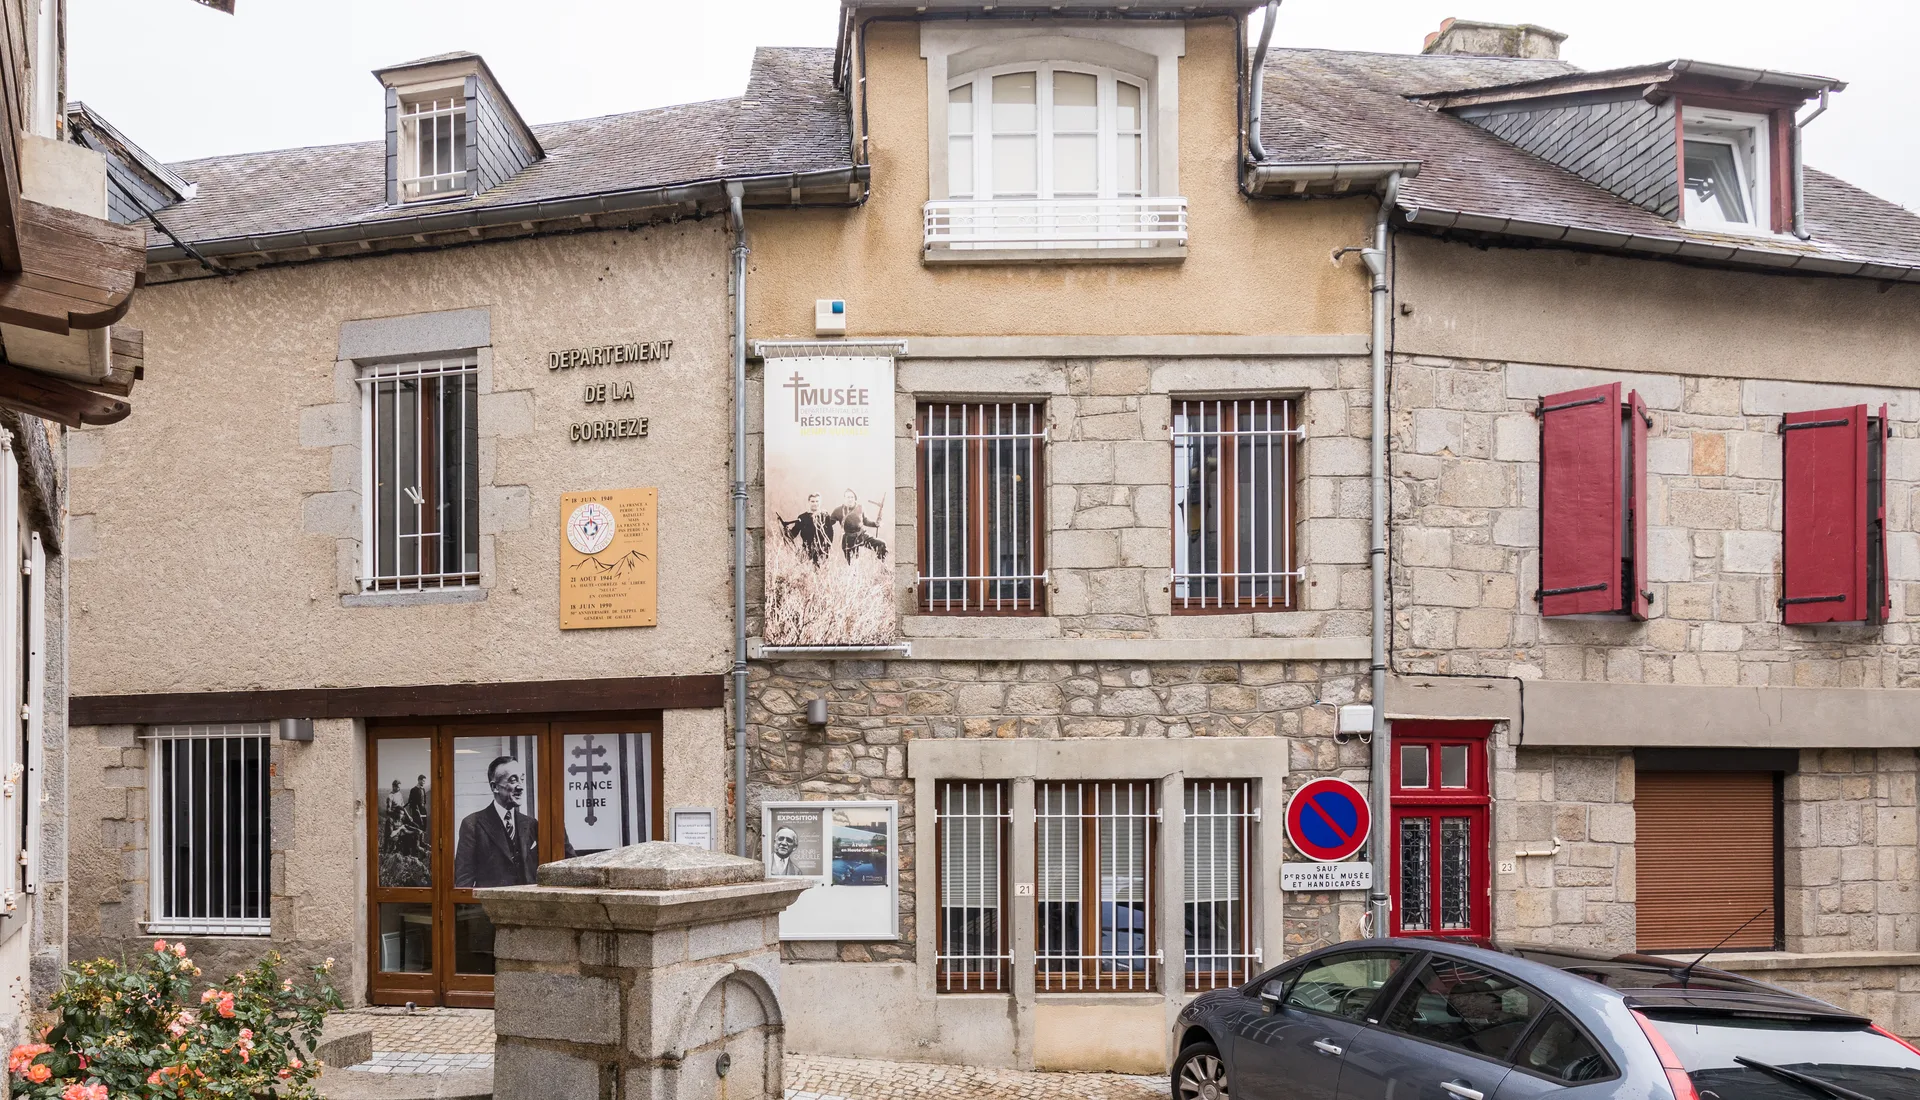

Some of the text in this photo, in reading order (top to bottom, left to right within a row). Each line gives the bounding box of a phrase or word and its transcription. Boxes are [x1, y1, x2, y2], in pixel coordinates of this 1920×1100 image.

[548, 339, 673, 370] DEPARTEMENT
[584, 381, 634, 403] DE LA
[800, 384, 869, 406] MUSÉE
[800, 414, 869, 427] RÉSISTANCE
[570, 417, 648, 441] CORREZE
[568, 780, 613, 791] FRANCE
[575, 797, 607, 808] LIBRE
[1502, 863, 1512, 871] 23
[1019, 885, 1030, 894] 21
[1307, 879, 1361, 888] HANDICAPÉS
